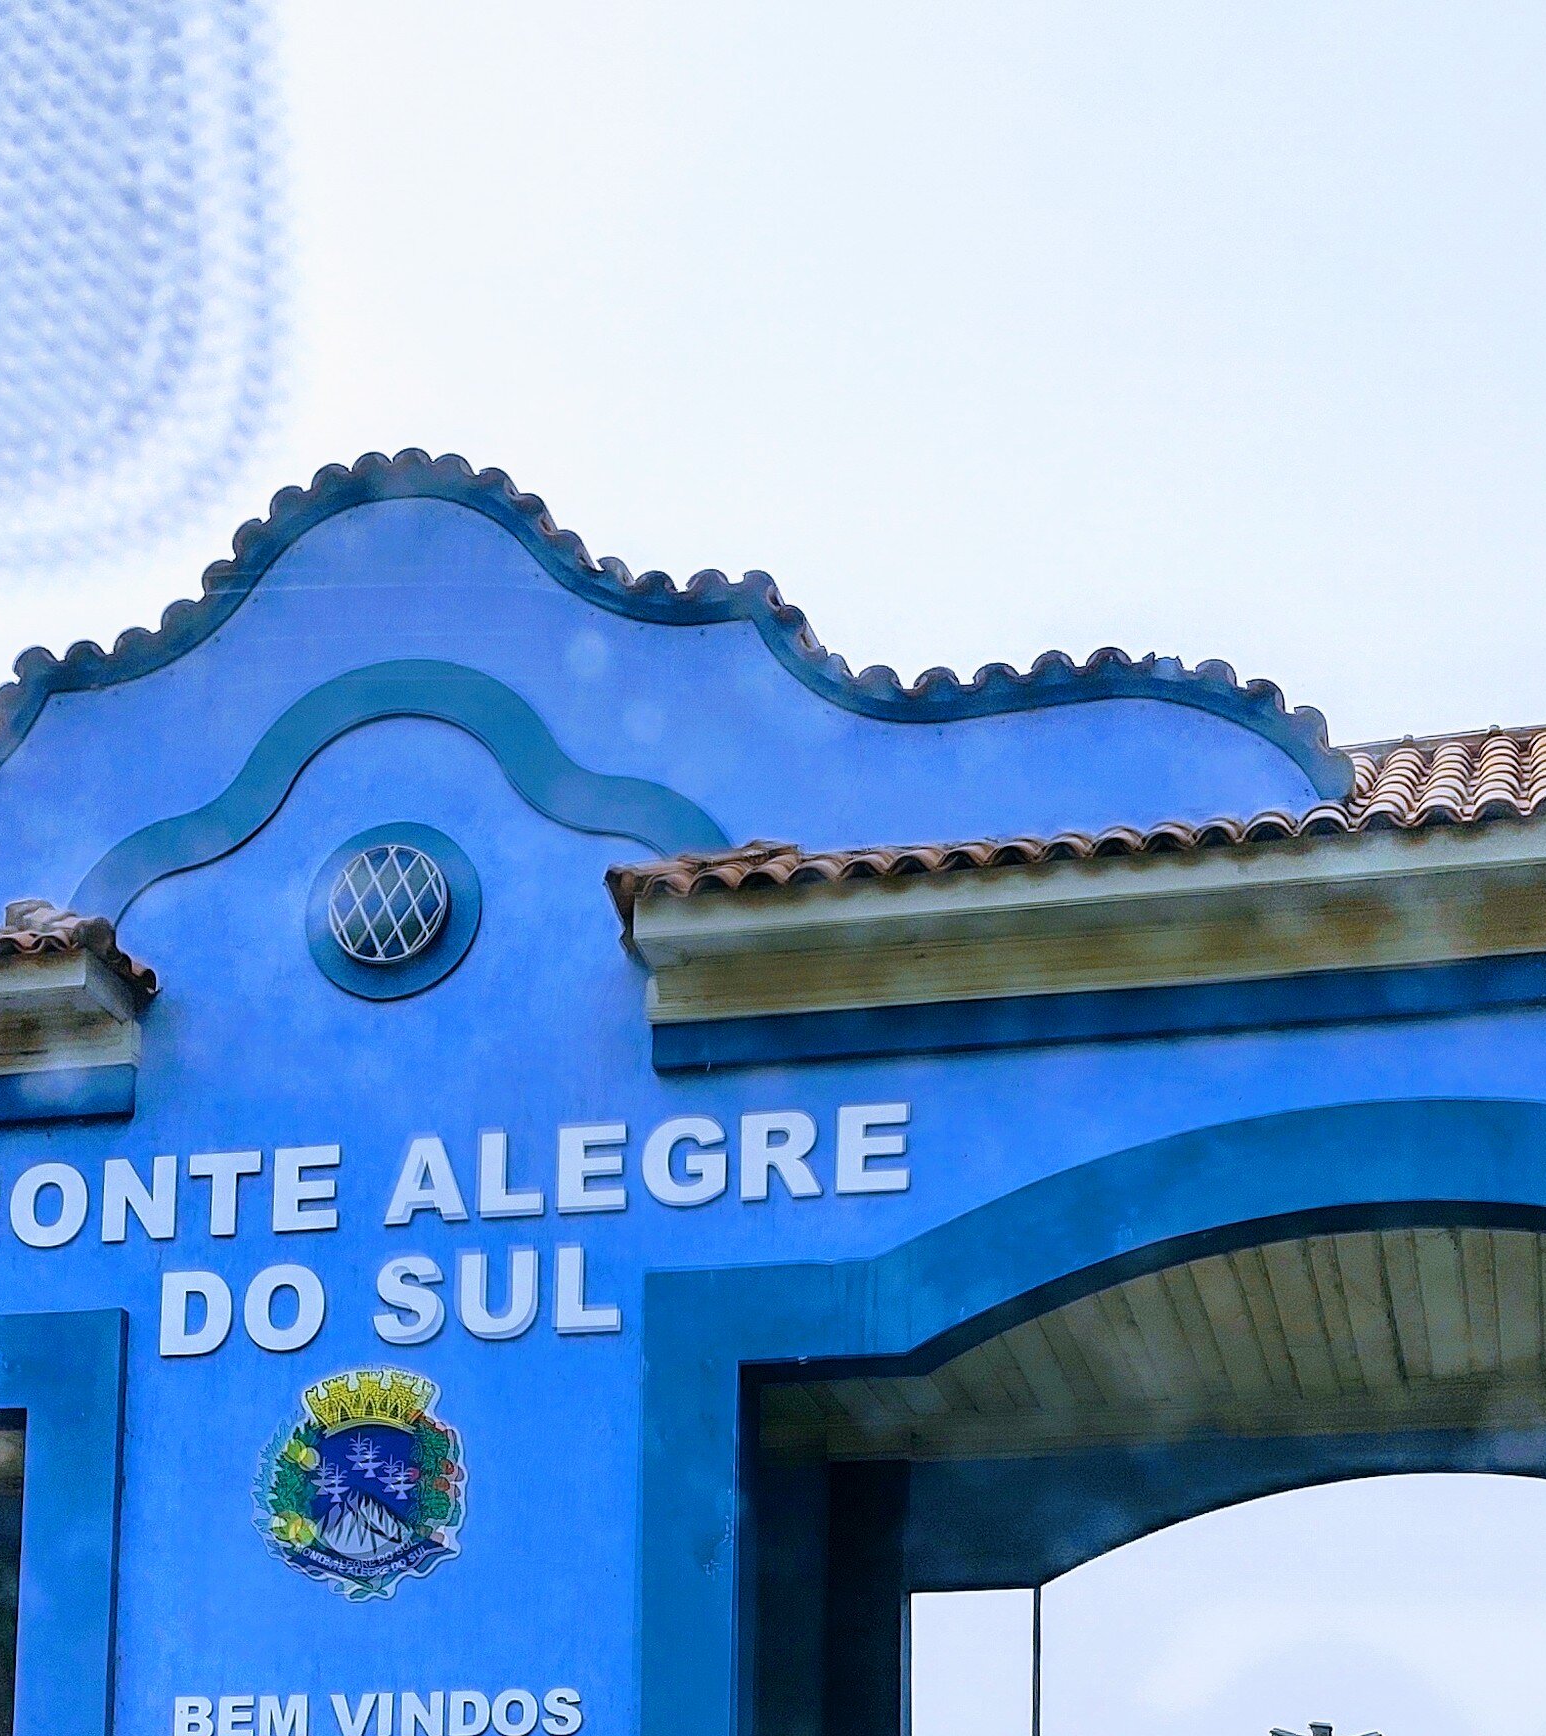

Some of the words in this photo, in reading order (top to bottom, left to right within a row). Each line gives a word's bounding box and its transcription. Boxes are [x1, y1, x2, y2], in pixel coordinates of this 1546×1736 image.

[382, 1101, 911, 1226] ALEGRE
[158, 1264, 327, 1357] DO
[372, 1242, 621, 1345] SUL
